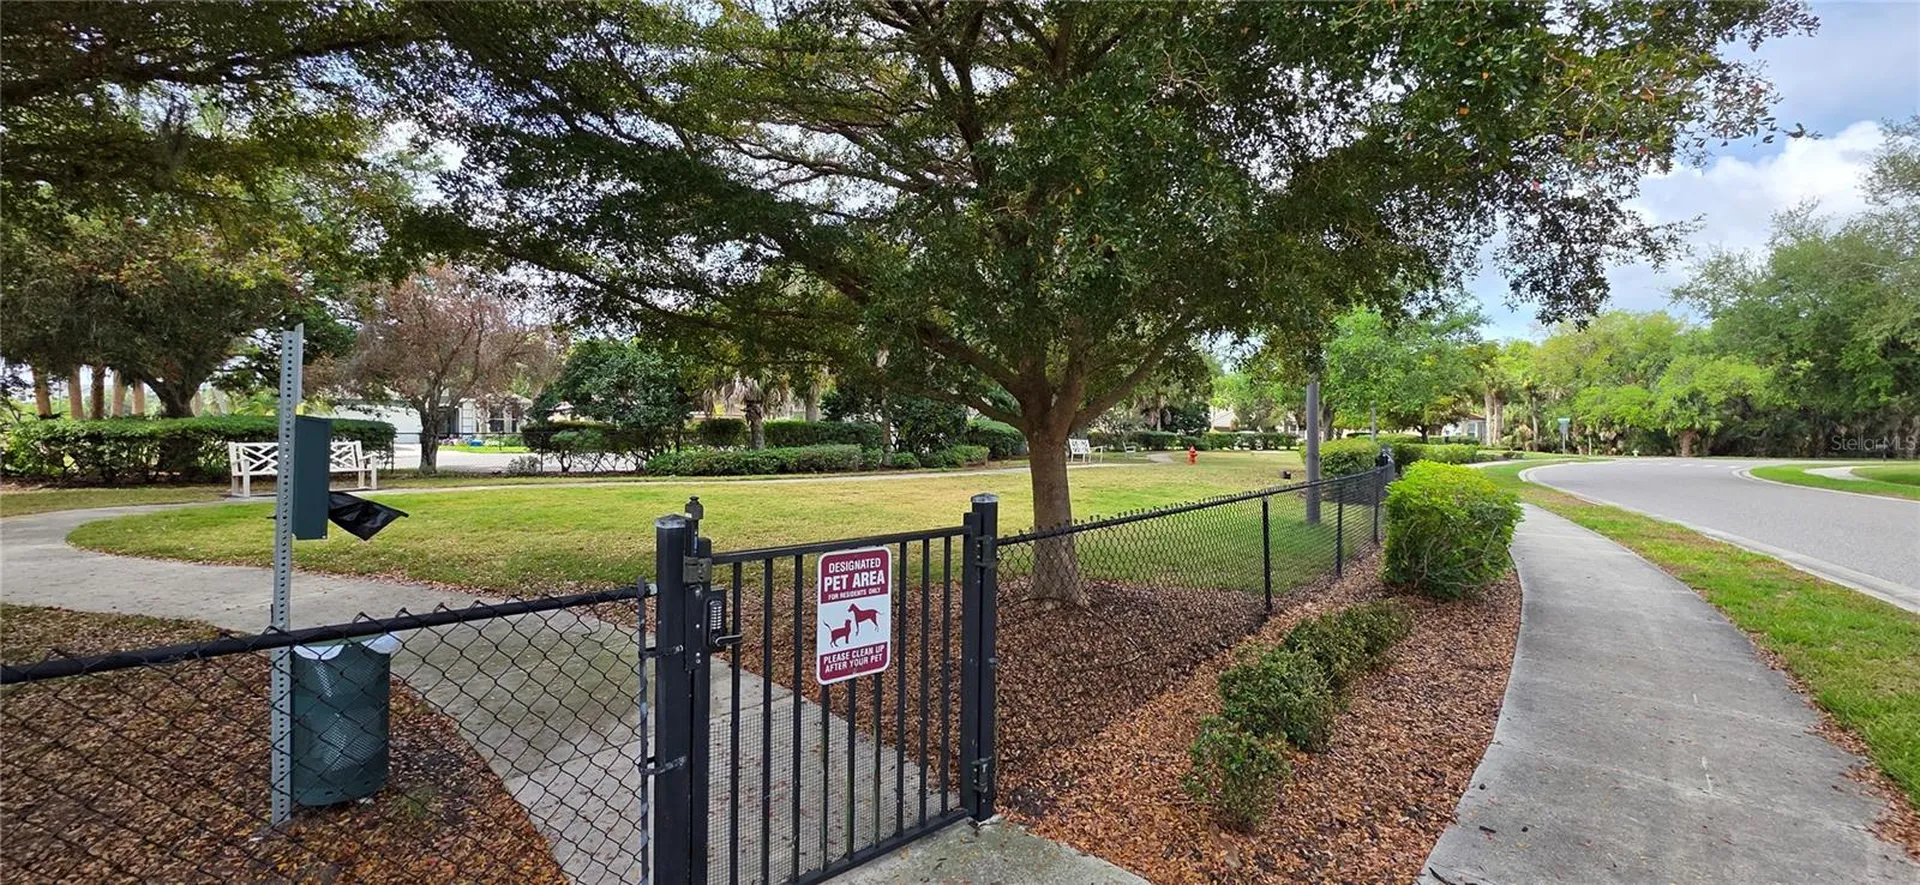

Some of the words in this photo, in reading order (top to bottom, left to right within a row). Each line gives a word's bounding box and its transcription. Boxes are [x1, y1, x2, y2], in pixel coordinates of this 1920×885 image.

[829, 557, 881, 573] DESIGNATED
[824, 574, 849, 592] PET
[852, 569, 885, 588] AREA
[828, 593, 839, 601] FOR
[840, 588, 867, 599] RESIDENTS
[868, 587, 881, 595] ONLY
[823, 652, 850, 665] PLEASE
[851, 646, 874, 659] CLEAN
[875, 644, 885, 653] UP
[825, 660, 848, 674] AFTER
[849, 657, 869, 668] YOUR
[870, 653, 883, 664] PET
